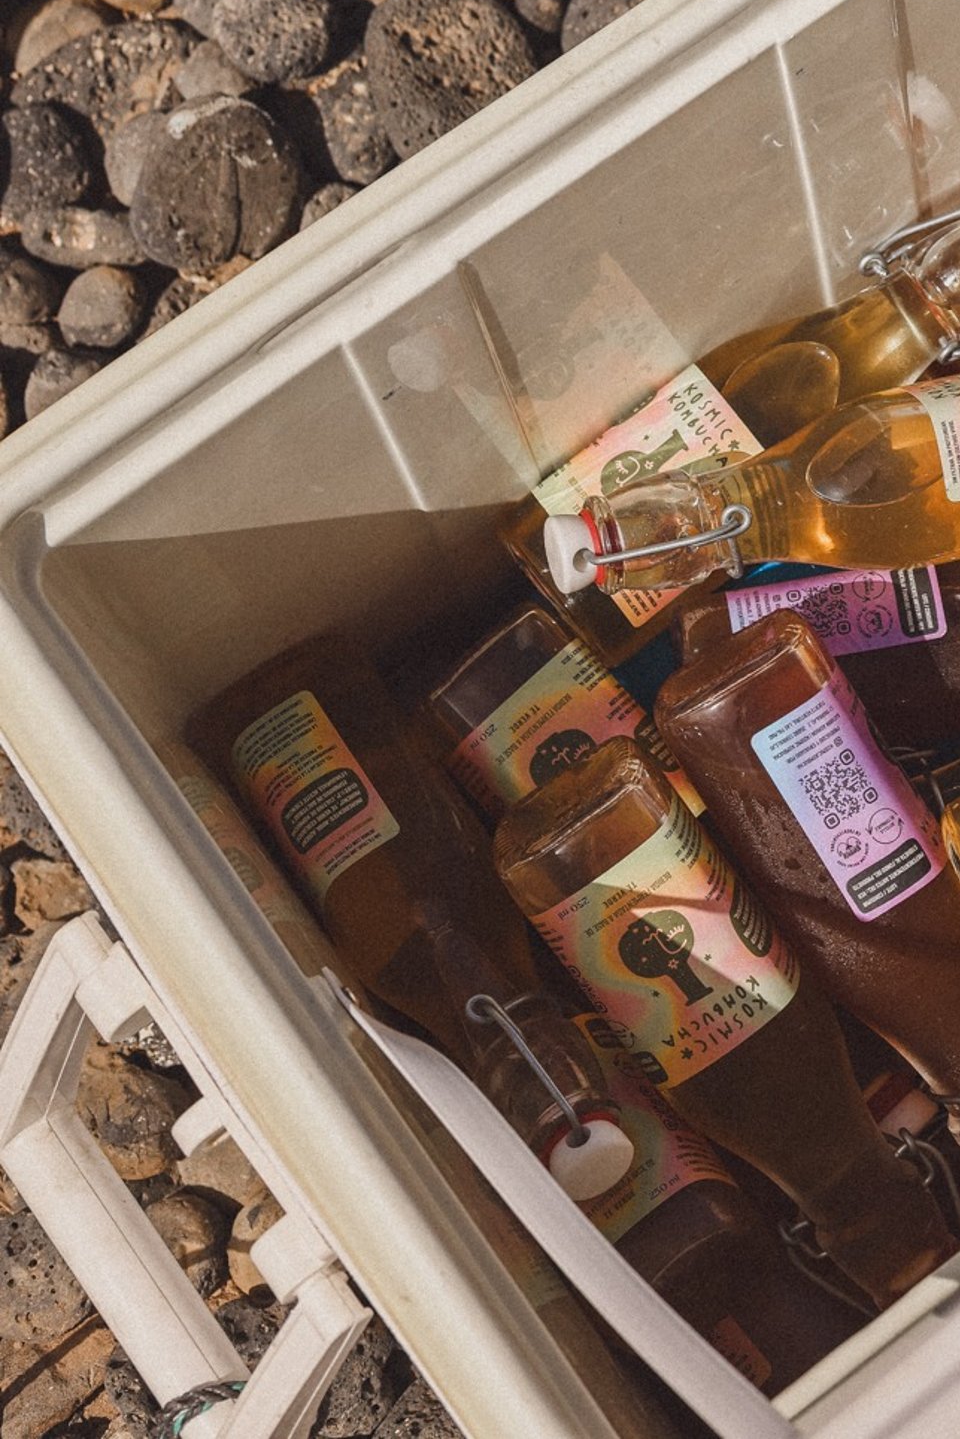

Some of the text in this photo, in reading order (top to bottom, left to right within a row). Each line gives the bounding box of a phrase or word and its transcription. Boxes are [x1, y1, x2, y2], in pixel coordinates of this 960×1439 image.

[667, 392, 729, 467] KOMBUCHA
[683, 383, 733, 441] KOSMIC
[571, 897, 589, 912] 250
[603, 890, 626, 907] VERDE
[662, 975, 760, 1047] KOMBUCHA
[699, 994, 768, 1054] KOSMIC
